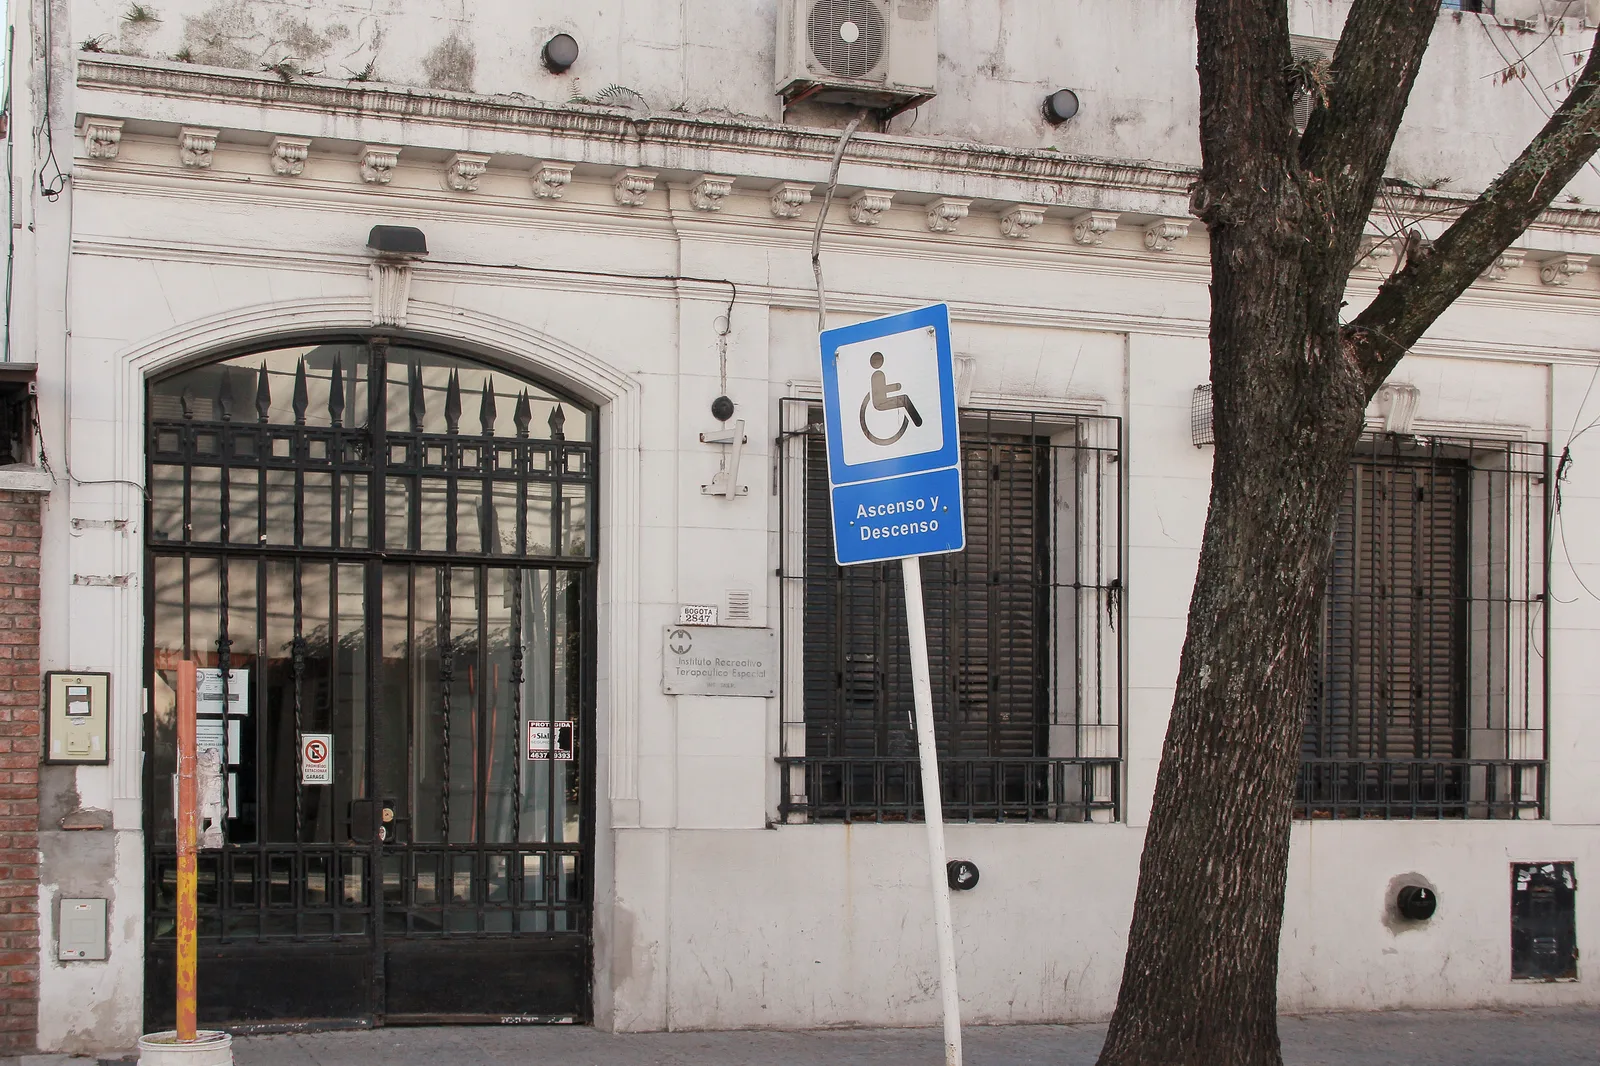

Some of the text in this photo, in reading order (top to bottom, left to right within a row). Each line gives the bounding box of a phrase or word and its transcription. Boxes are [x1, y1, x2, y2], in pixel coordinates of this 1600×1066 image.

[856, 495, 939, 519] Ascenso y
[860, 519, 939, 541] Descenso
[685, 614, 710, 622] 2847
[678, 657, 762, 667] Instituto Recreativo
[732, 669, 766, 679] Especial
